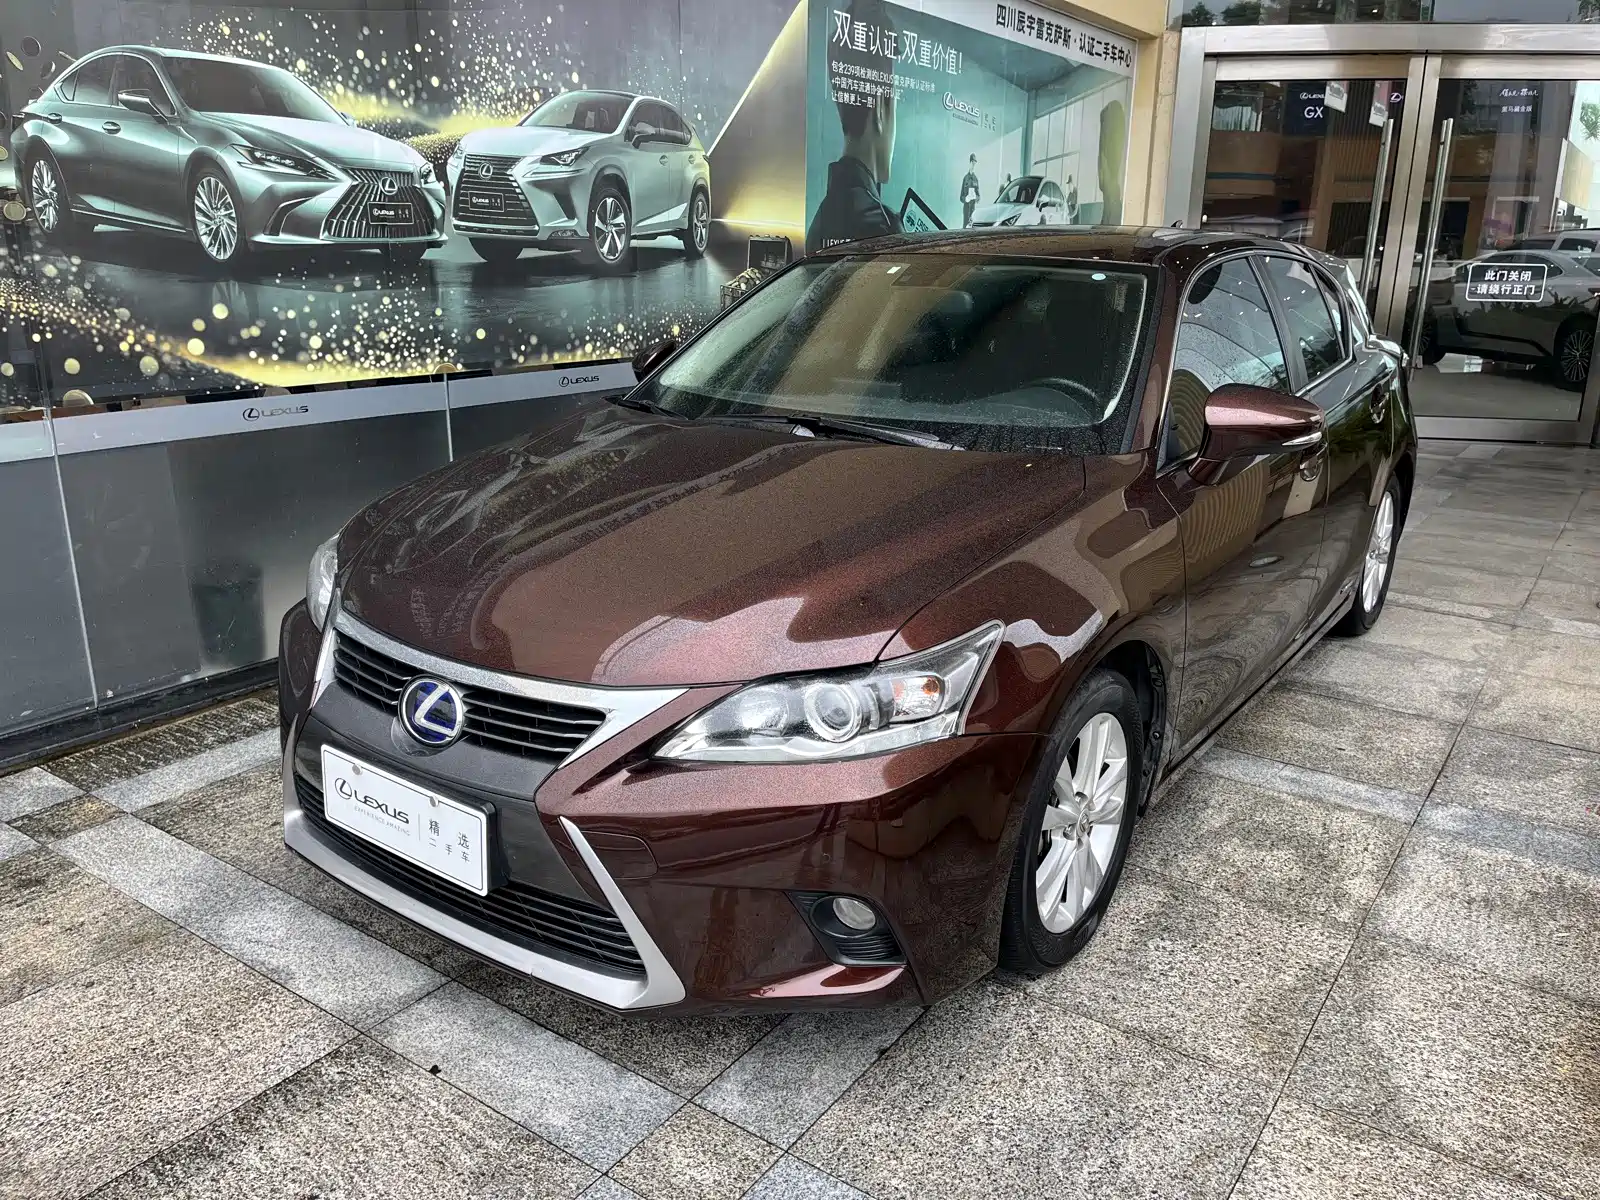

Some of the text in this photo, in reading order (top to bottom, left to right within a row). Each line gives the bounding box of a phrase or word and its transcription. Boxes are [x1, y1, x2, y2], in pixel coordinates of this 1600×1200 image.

[1304, 106, 1323, 118] GX
[1484, 270, 1532, 281] 此门关闭
[1476, 284, 1535, 295] 请绕行正门
[570, 375, 600, 384] LEXUS
[261, 405, 309, 417] LEXUS
[354, 789, 409, 824] LEXUS
